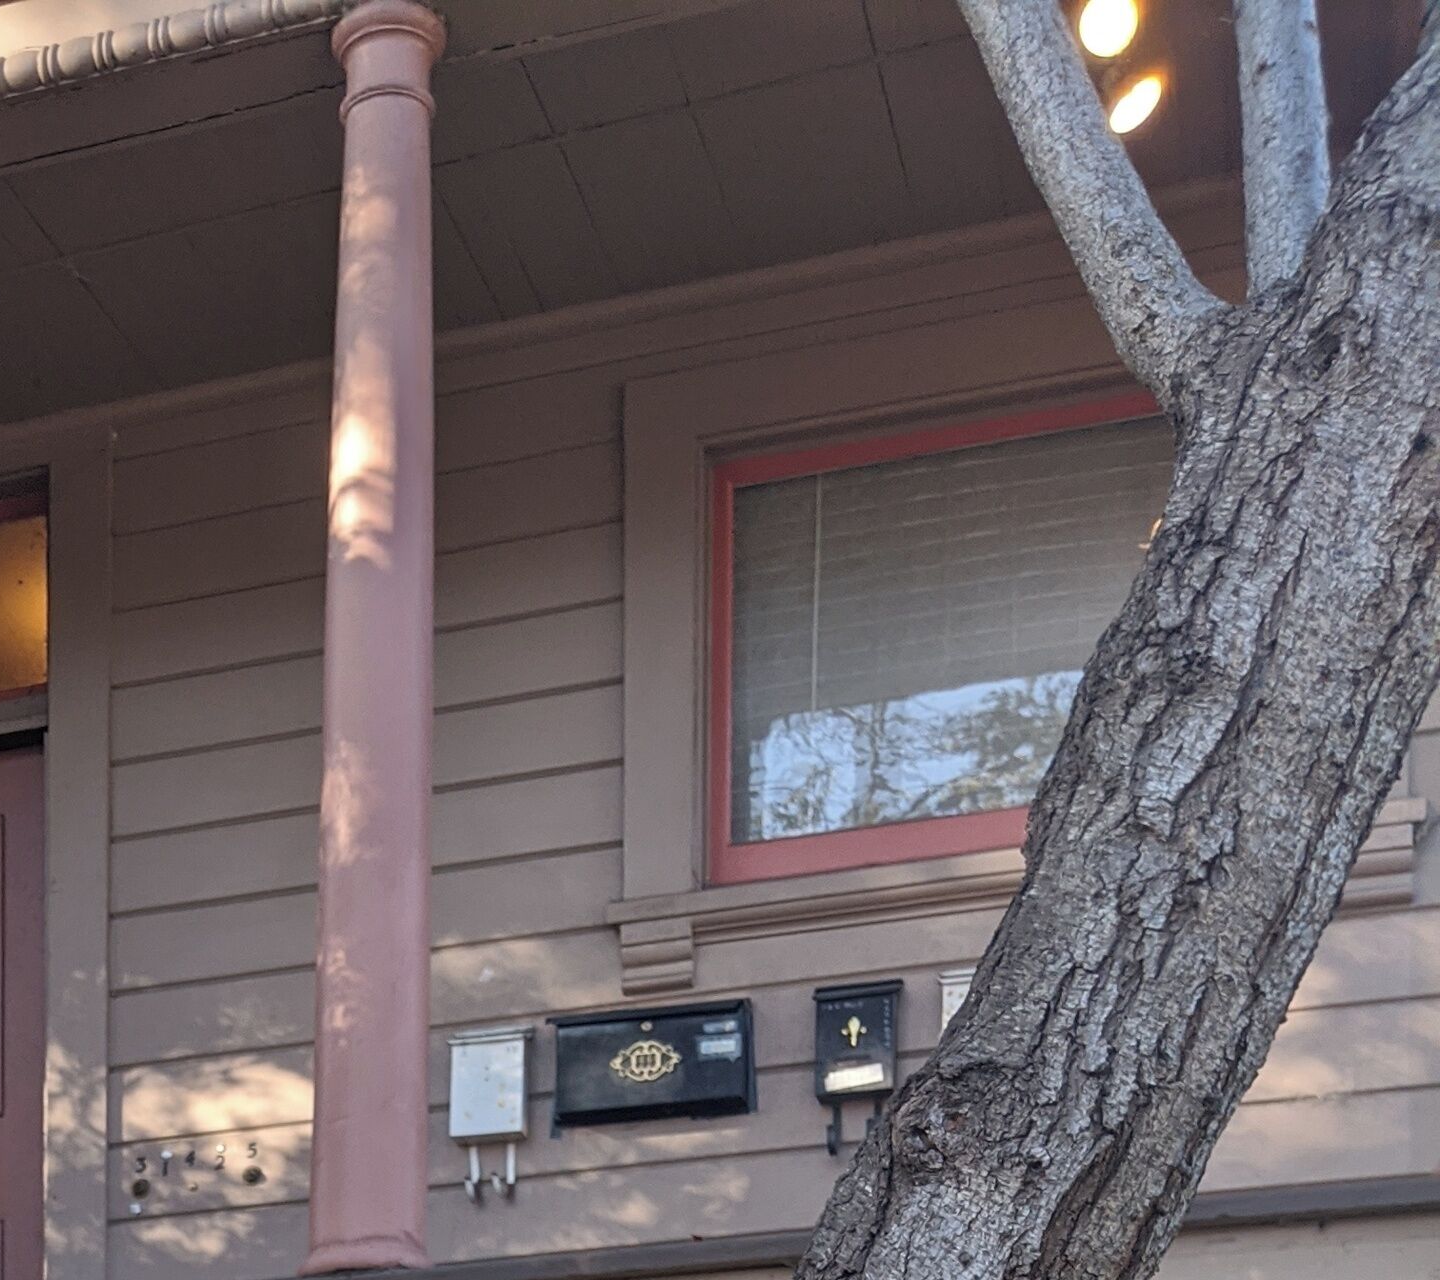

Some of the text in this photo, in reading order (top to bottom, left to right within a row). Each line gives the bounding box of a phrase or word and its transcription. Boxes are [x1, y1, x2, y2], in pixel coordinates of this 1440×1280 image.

[135, 1156, 147, 1173] 3
[185, 1150, 196, 1168] 4
[214, 1154, 225, 1171] 2
[247, 1142, 258, 1159] 5
